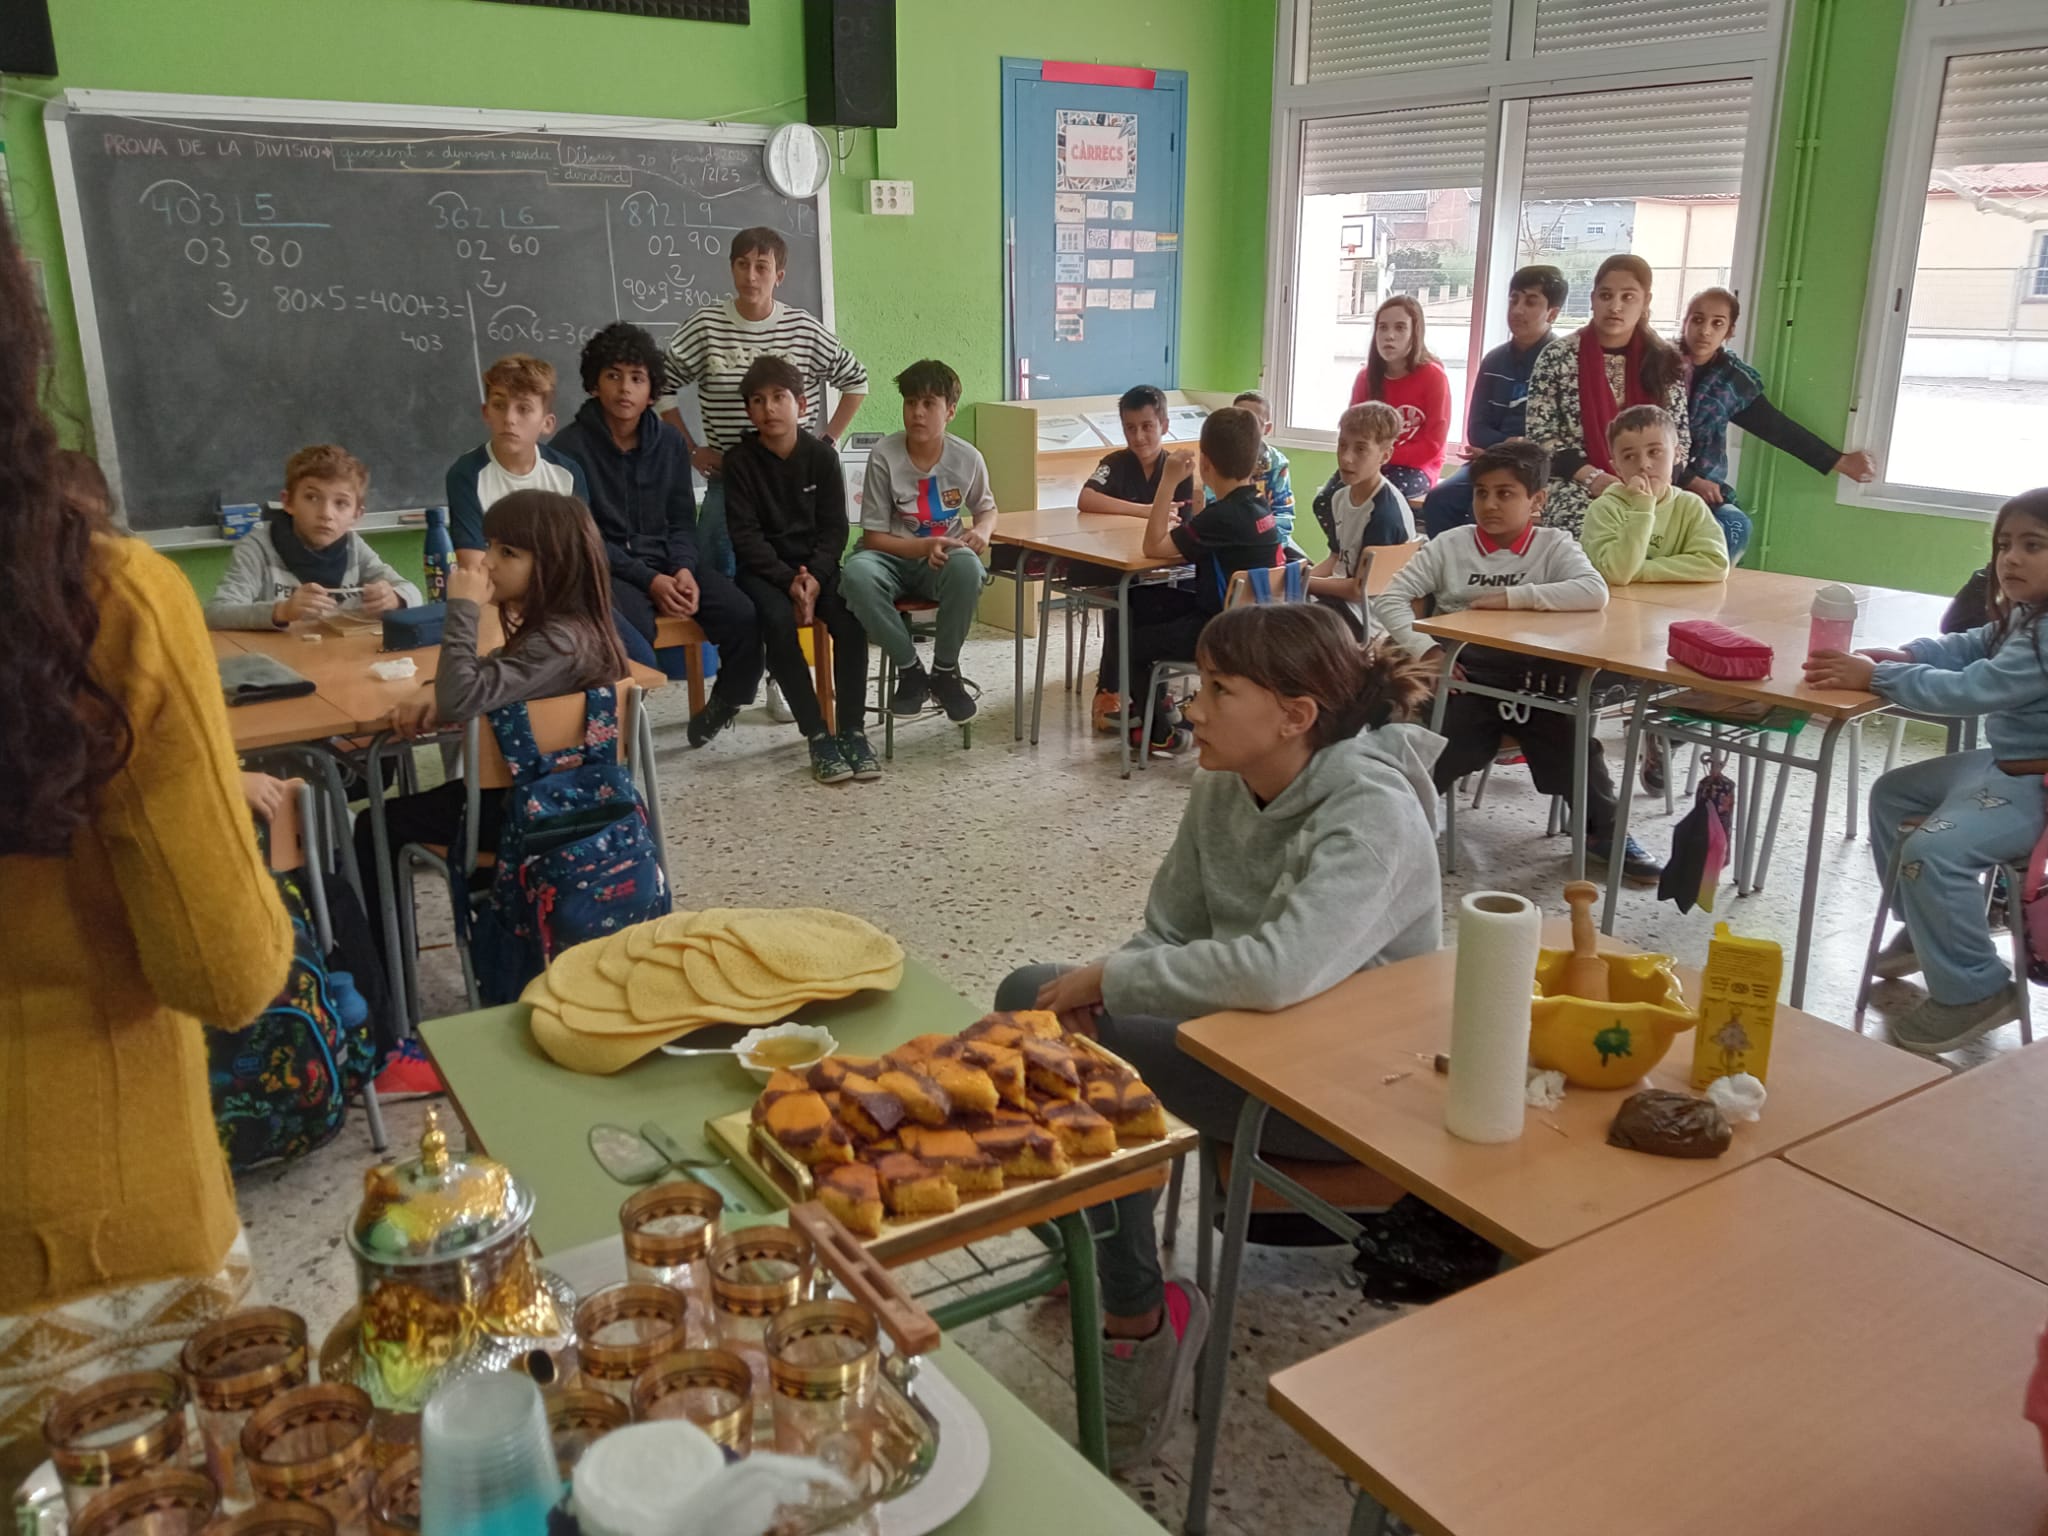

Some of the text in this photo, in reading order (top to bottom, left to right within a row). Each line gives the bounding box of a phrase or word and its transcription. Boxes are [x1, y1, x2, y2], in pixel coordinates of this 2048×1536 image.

[103, 132, 168, 157] PROVA
[178, 138, 206, 157] DE
[218, 140, 241, 157] LA
[1071, 140, 1124, 162] CÀRRECS
[151, 191, 225, 227] 403
[255, 192, 276, 222] 5
[434, 203, 490, 230] 362
[518, 206, 534, 225] 6
[627, 200, 677, 227] 812
[698, 202, 713, 226] 9
[184, 236, 232, 269] 03
[250, 234, 303, 268] 80
[456, 239, 496, 261] 02
[508, 234, 540, 257] 60
[648, 234, 681, 258] 02
[688, 231, 721, 256] 90
[479, 270, 497, 290] 2
[668, 264, 688, 282] 2
[215, 281, 238, 307] 3
[400, 332, 444, 353] 403
